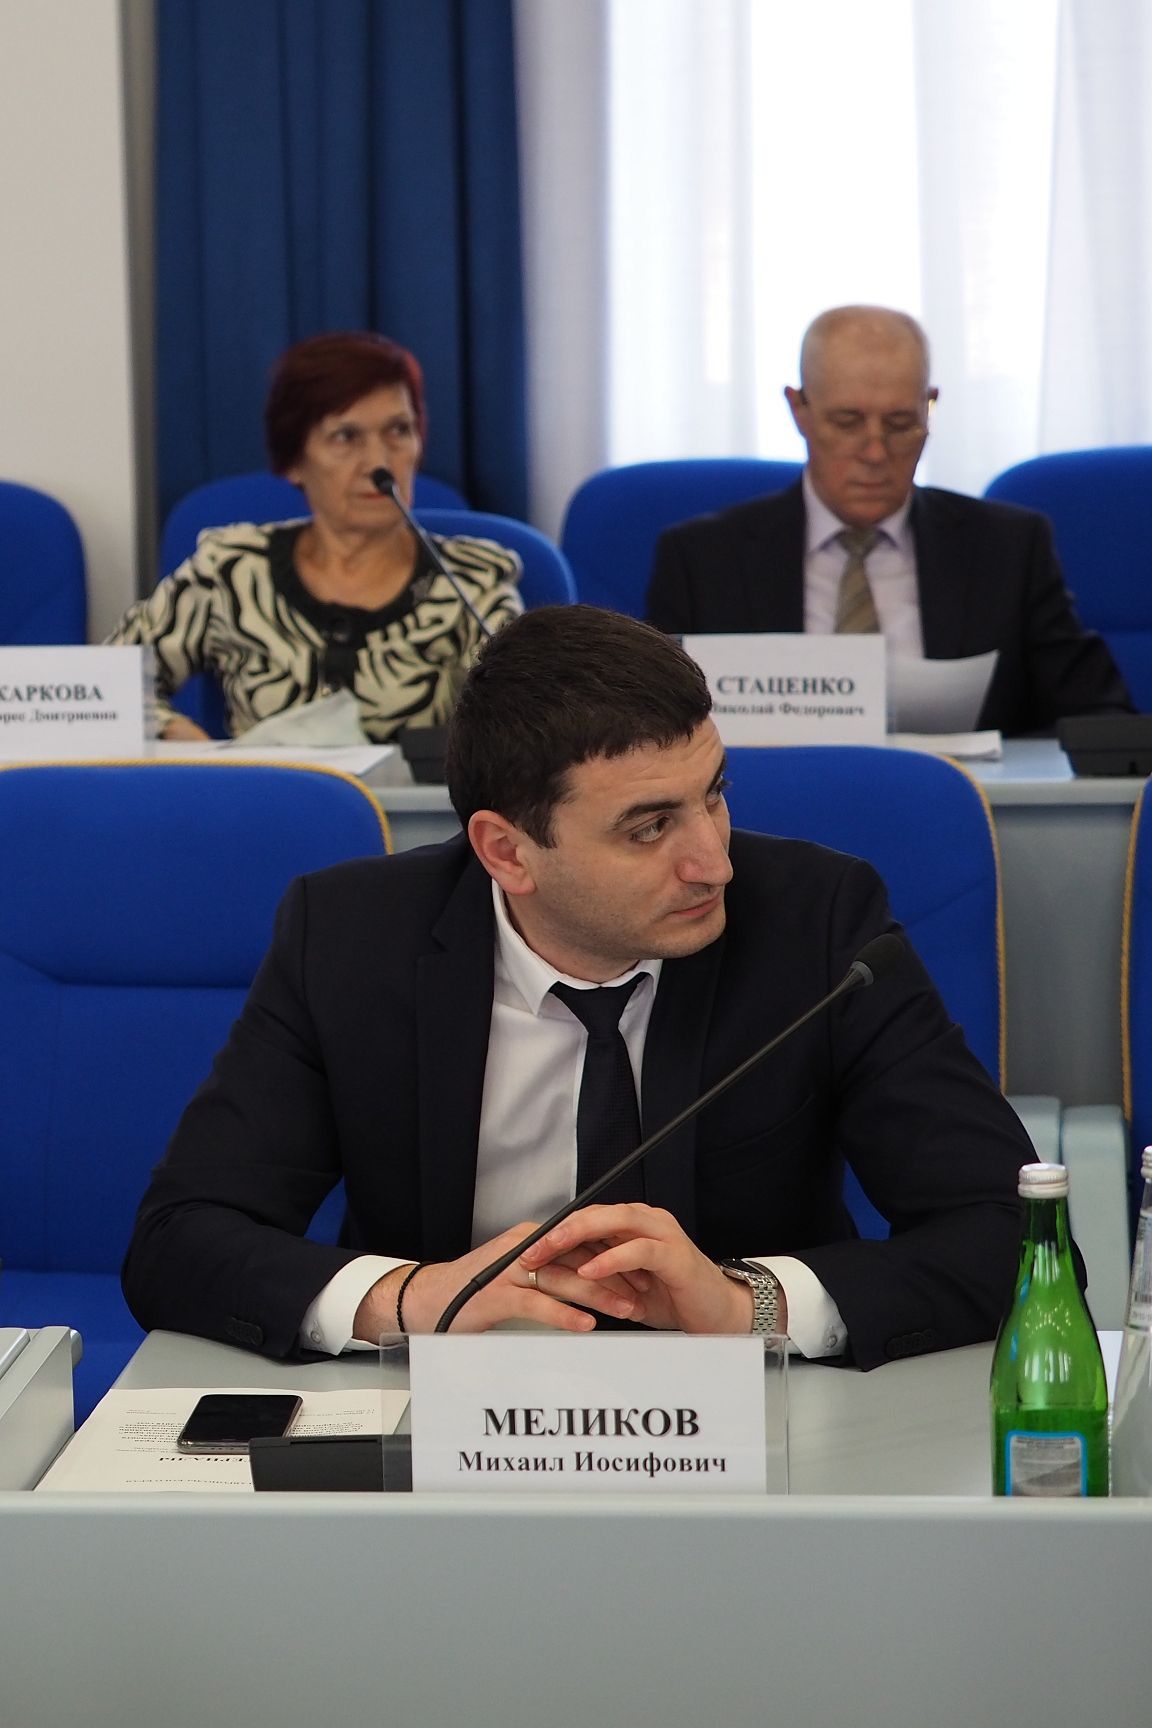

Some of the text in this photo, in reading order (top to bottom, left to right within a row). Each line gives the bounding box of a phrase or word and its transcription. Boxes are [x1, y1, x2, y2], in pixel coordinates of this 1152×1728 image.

[716, 676, 856, 697] СТАЦЕНКО
[481, 1407, 701, 1437] МЕЛИКОВ
[457, 1450, 728, 1478] Михаил Иосифович
